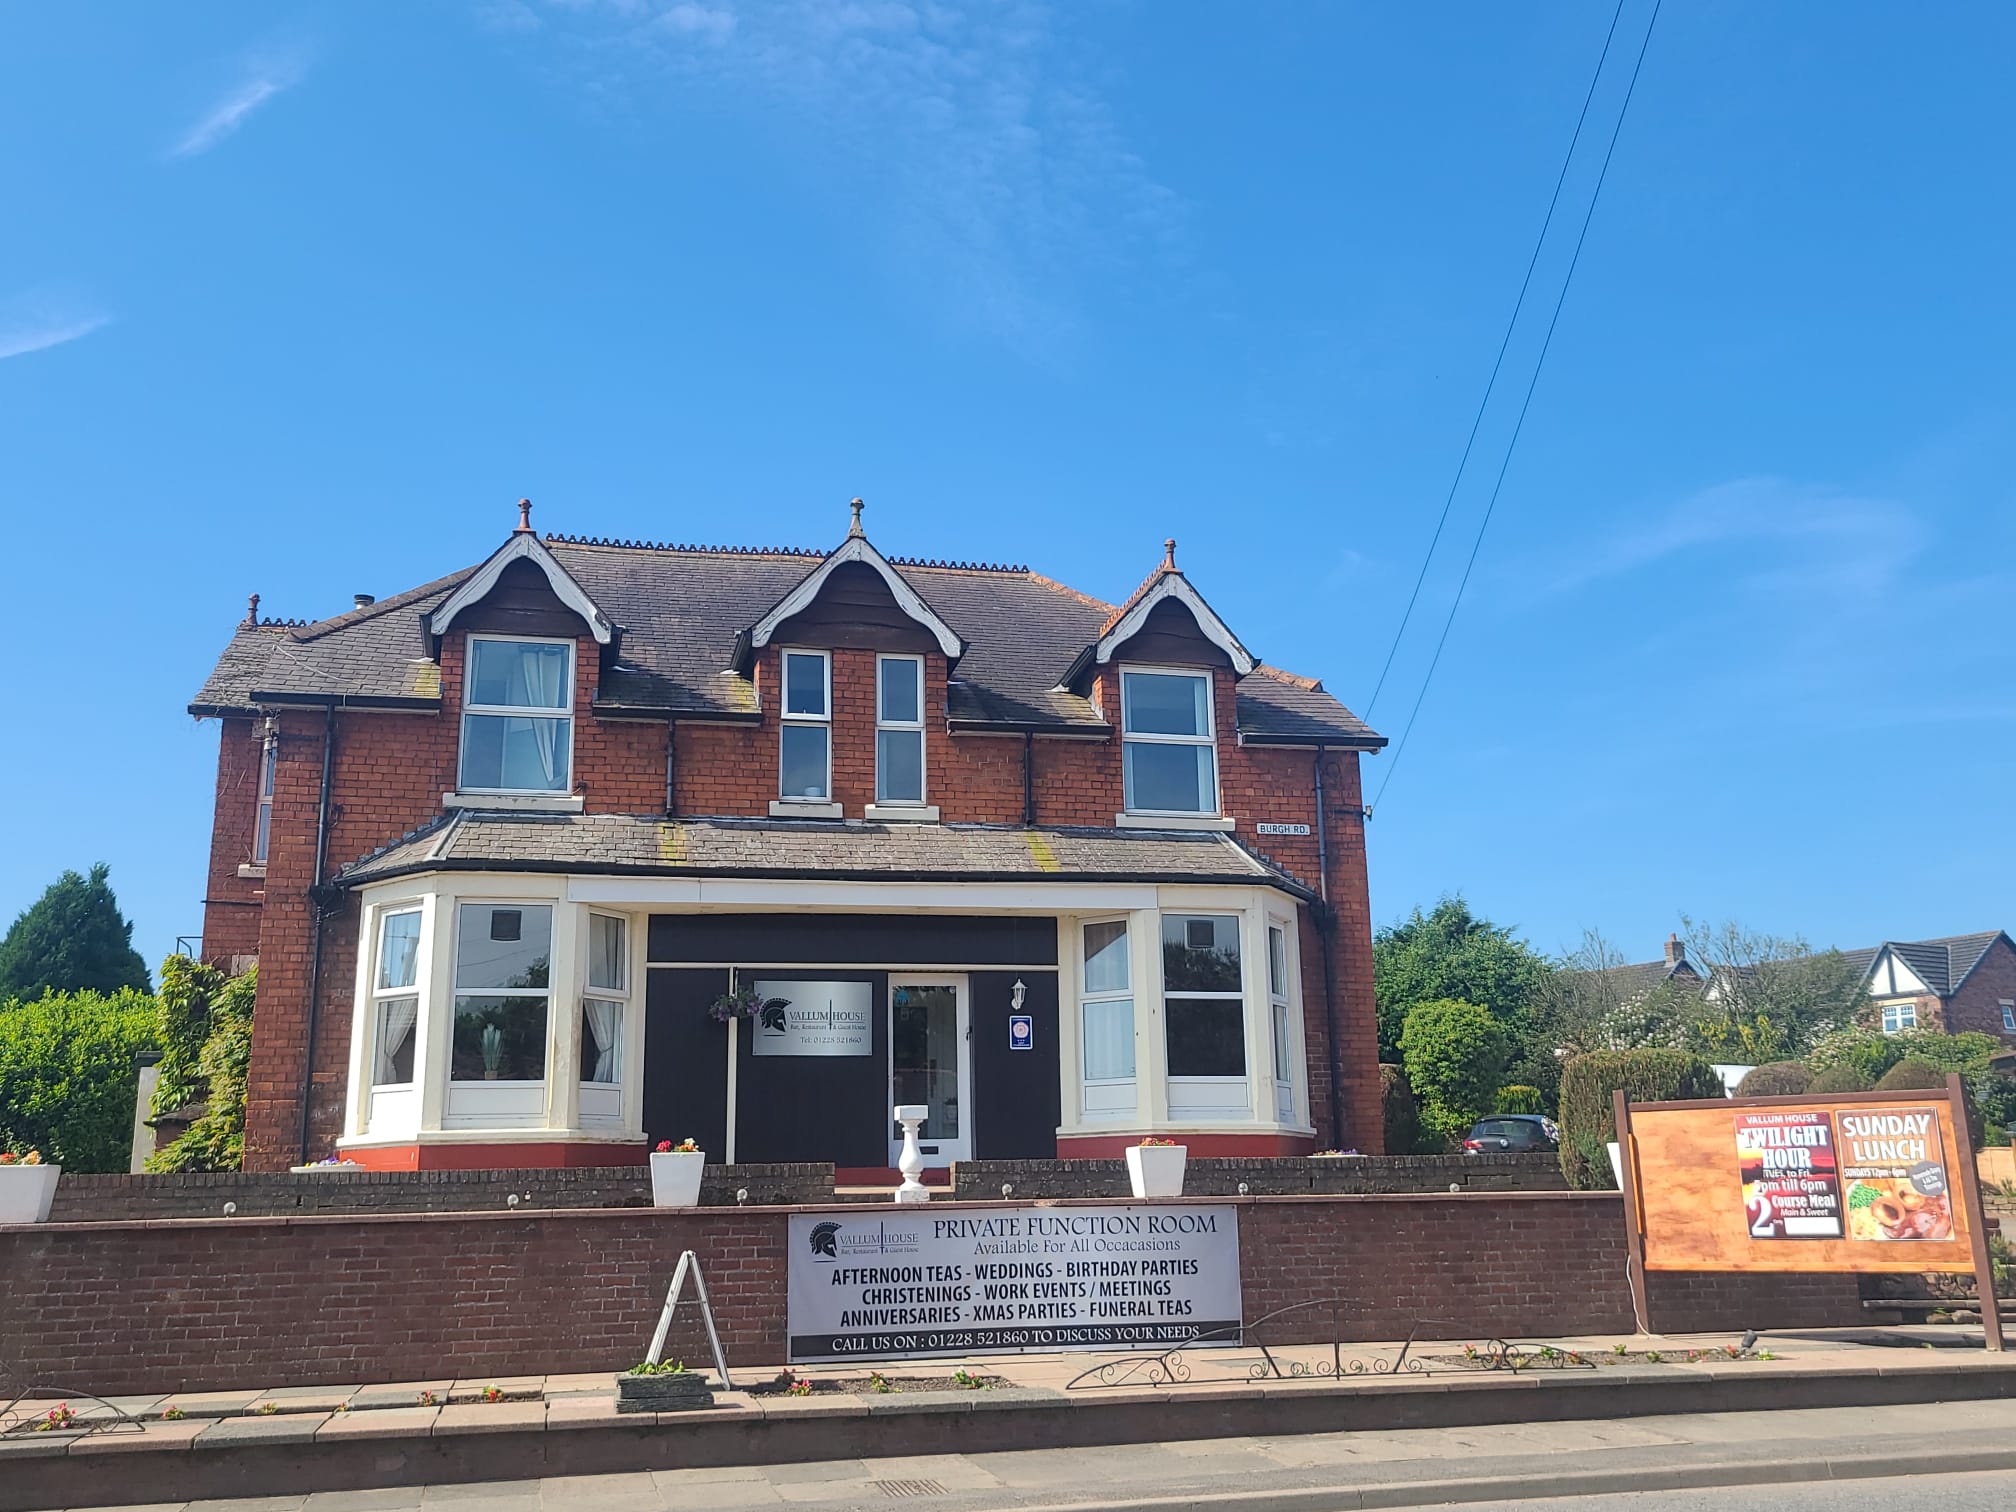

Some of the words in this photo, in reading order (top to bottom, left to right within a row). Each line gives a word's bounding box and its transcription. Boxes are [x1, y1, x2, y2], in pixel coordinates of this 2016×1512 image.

[1260, 824, 1290, 833] BURGH
[1294, 825, 1309, 834] RD.
[789, 1011, 828, 1021] VALLUM
[833, 1011, 865, 1021] HOUSE
[813, 1036, 835, 1044] 01228
[837, 1036, 862, 1044] 521860
[1745, 1115, 1783, 1124] VALLUM
[1785, 1114, 1818, 1123] HOUSE
[1842, 1114, 1930, 1137] SUNDAY
[1740, 1125, 1828, 1148] TWILIGHT
[1762, 1147, 1812, 1168] HOUR
[1852, 1139, 1925, 1161] LUNCH
[1787, 1170, 1797, 1178] to
[1844, 1168, 1871, 1178] SUNDAYS
[1871, 1167, 1888, 1178] 12pm
[1781, 1178, 1798, 1192] till
[1800, 1180, 1826, 1193] 6pm
[1771, 1194, 1808, 1208] Course
[1808, 1194, 1836, 1208] Meal
[1749, 1195, 1775, 1236] 2
[1780, 1208, 1799, 1216] Main
[1800, 1208, 1806, 1216] &
[1807, 1208, 1829, 1216] Sweet
[934, 1217, 1020, 1239] PRIVATE
[1027, 1216, 1141, 1236] FUNCTION
[1148, 1215, 1218, 1234] ROOM
[840, 1234, 880, 1245] VALLUM
[884, 1232, 919, 1243] HOUSE
[974, 1239, 1038, 1255] Available
[1043, 1239, 1066, 1253] For
[1070, 1238, 1089, 1252] All
[1094, 1237, 1181, 1252] Occacasions
[832, 1266, 922, 1286] AFTERNOON
[926, 1265, 962, 1282] TEAS
[974, 1262, 1053, 1280] WEDDINGS
[1066, 1260, 1137, 1277] BIRTHDAY
[1142, 1259, 1199, 1276] PARTIES
[862, 1285, 971, 1305] CHRISTENINGS
[984, 1283, 1029, 1300] WORK
[1033, 1281, 1086, 1299] EVENTS
[1099, 1280, 1171, 1297] MEETINGS
[840, 1306, 960, 1327] ANNIVERSARIES
[973, 1304, 1014, 1321] XMAS
[1018, 1302, 1077, 1320] PARTIES
[1090, 1301, 1155, 1317] FUNERAL
[1158, 1299, 1192, 1316] TEAS
[832, 1338, 868, 1351] CALL
[872, 1336, 890, 1349] US
[893, 1335, 917, 1349] ON
[928, 1332, 973, 1347] 01228
[977, 1330, 1029, 1345] 521860
[1032, 1329, 1053, 1343] TO
[1056, 1328, 1111, 1342] DISCUSS
[1115, 1327, 1153, 1340] YOUR
[1156, 1325, 1200, 1339] NEEDS
